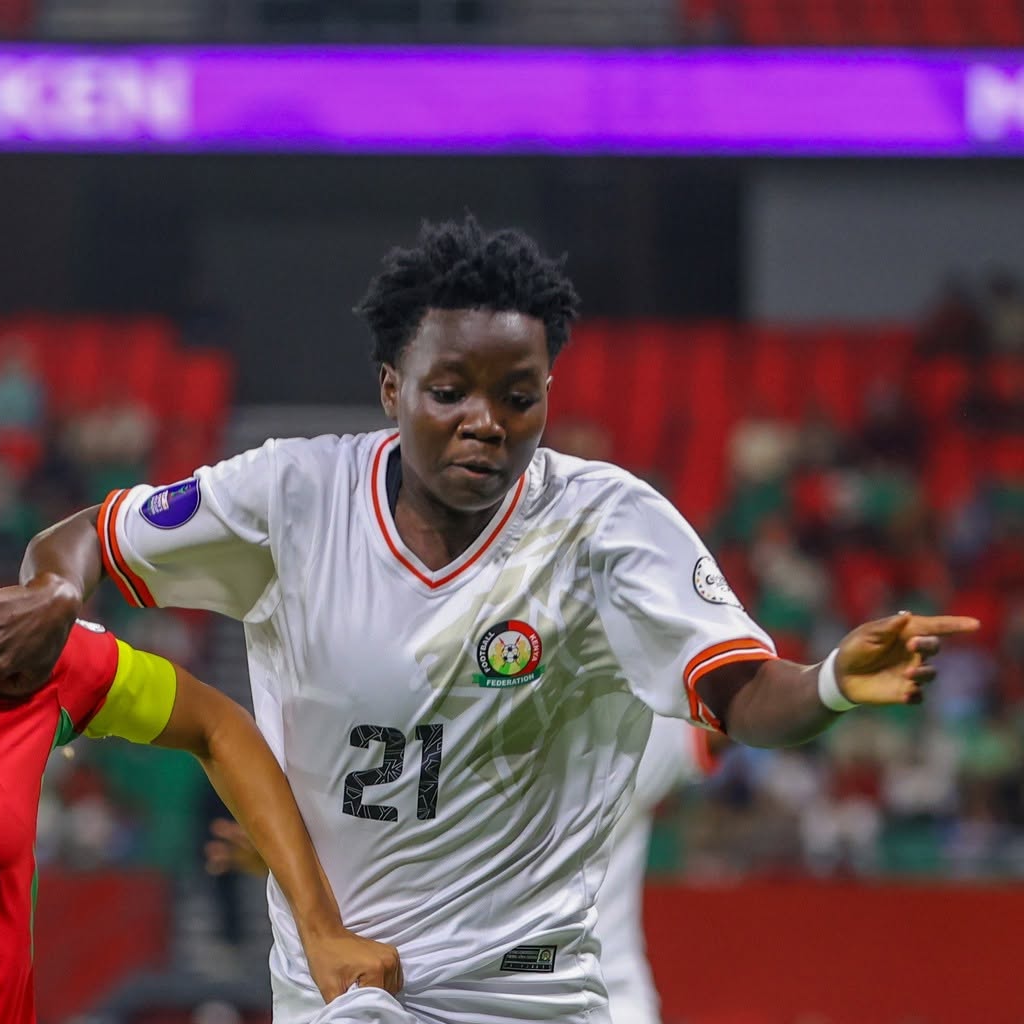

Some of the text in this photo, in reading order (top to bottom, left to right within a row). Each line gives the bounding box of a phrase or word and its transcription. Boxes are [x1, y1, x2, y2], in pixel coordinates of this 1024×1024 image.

[479, 631, 496, 674] FOOTBALL
[529, 633, 540, 662] KENYA
[486, 673, 535, 687] FEDERATION
[342, 723, 444, 822] 21
